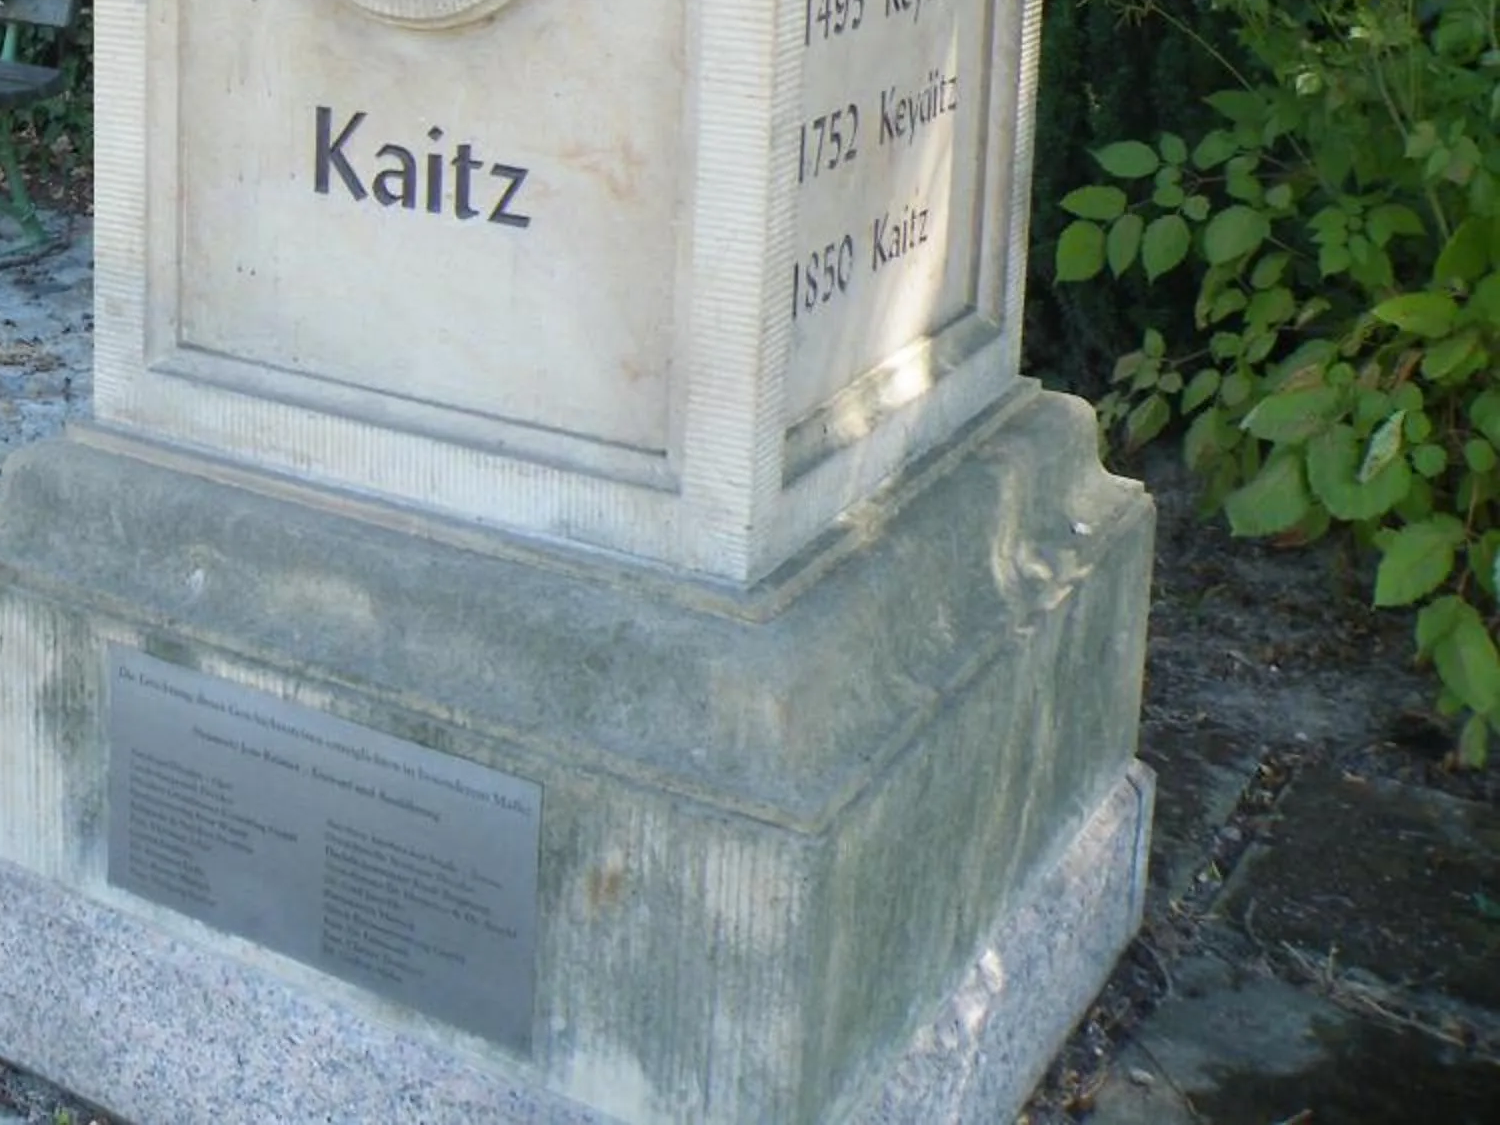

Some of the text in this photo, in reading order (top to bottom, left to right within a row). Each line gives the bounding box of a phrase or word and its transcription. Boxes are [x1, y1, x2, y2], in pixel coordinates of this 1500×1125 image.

[314, 106, 531, 228] Kaitz
[798, 103, 860, 184] 1752
[791, 204, 930, 322] 1850 Kaitz
